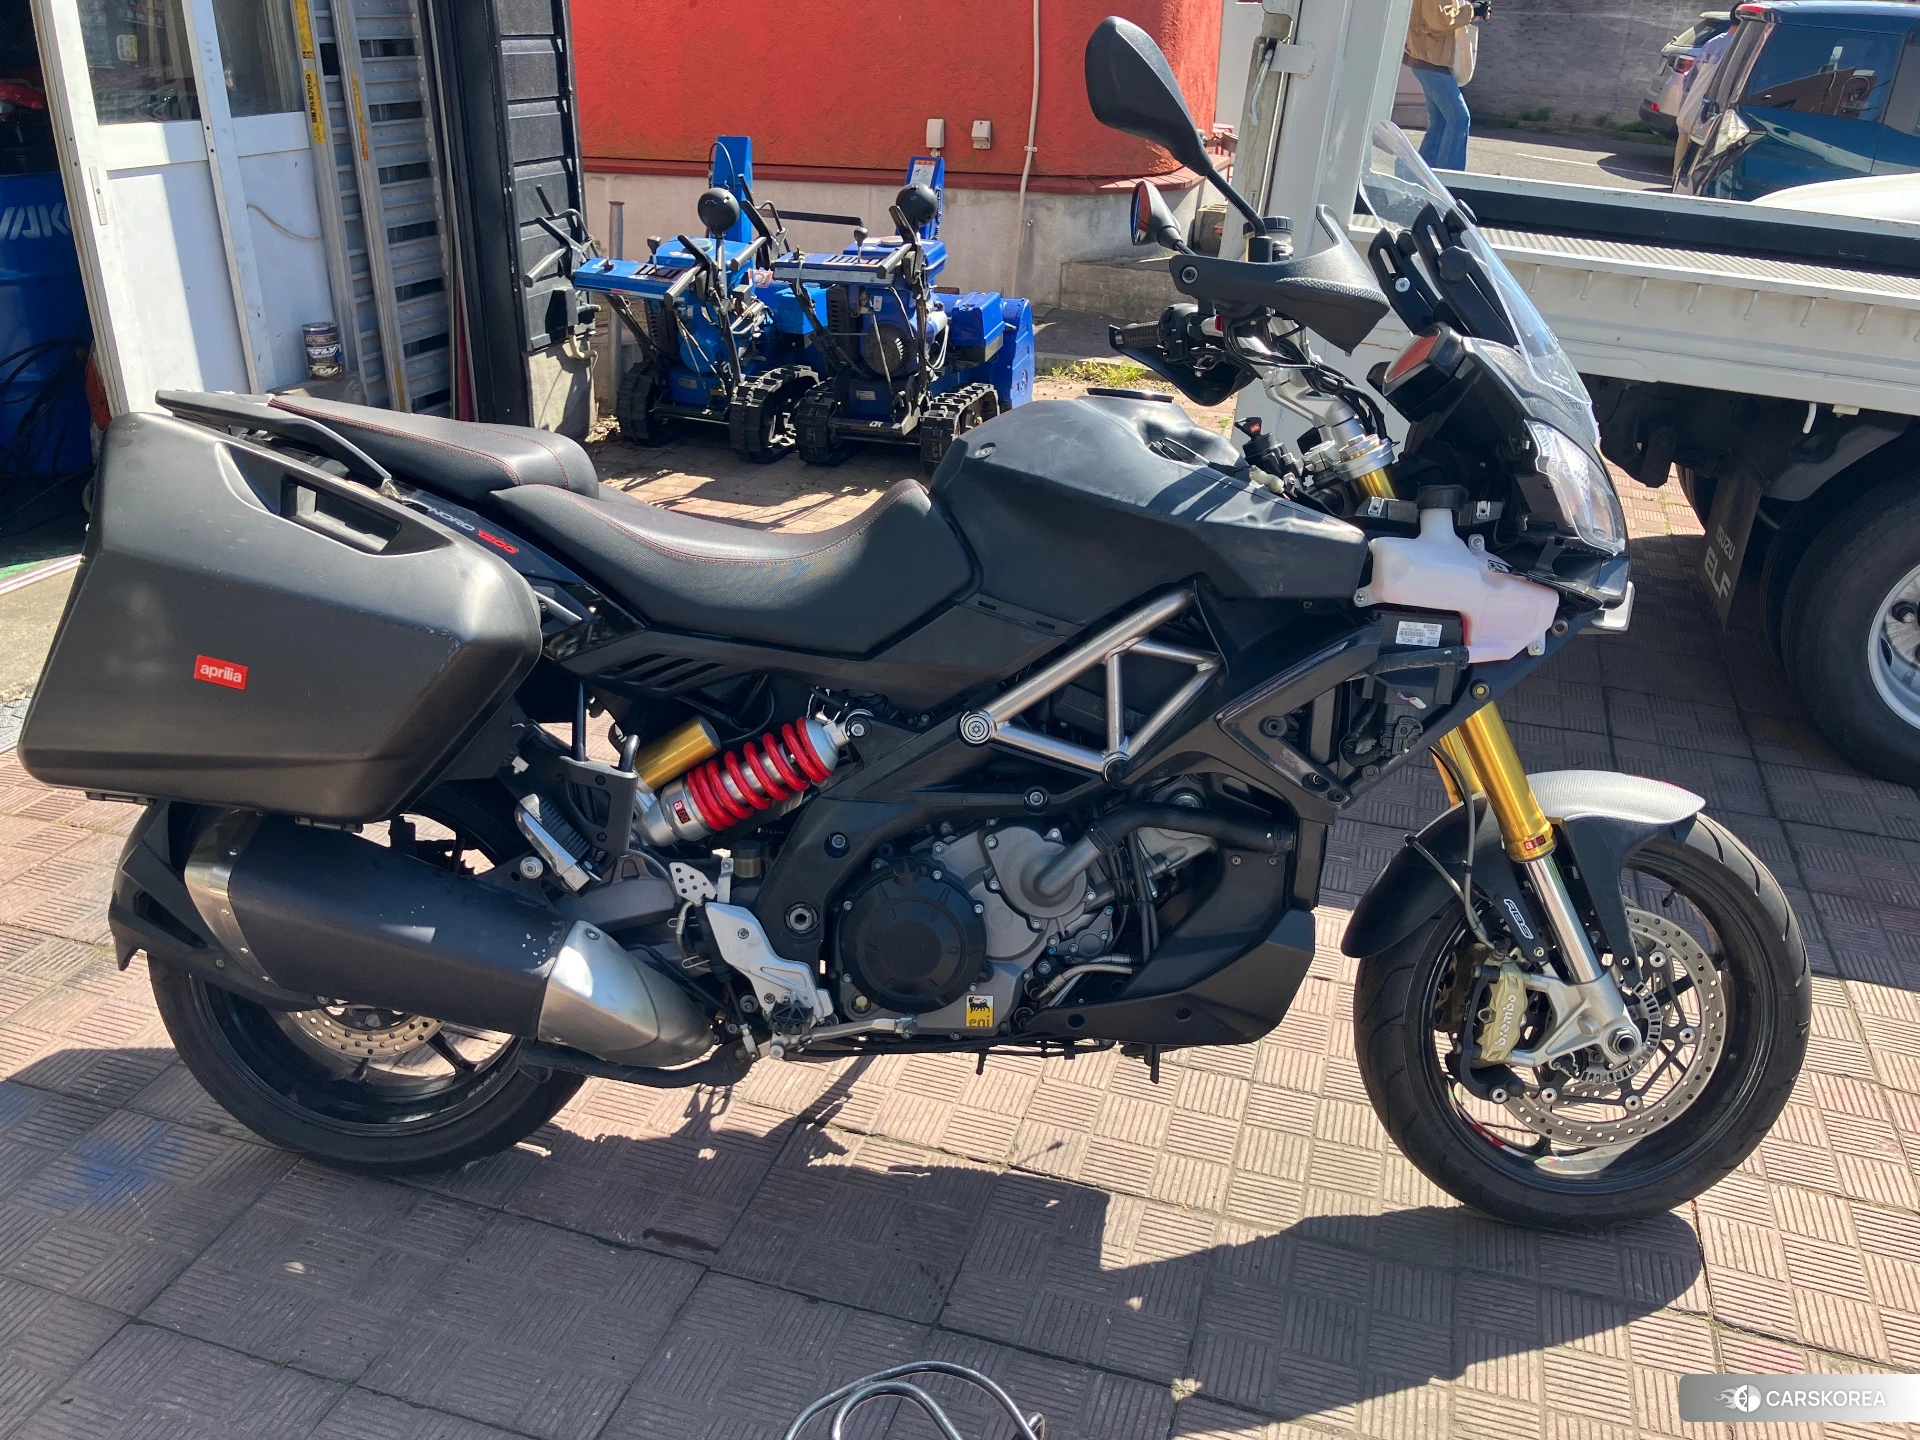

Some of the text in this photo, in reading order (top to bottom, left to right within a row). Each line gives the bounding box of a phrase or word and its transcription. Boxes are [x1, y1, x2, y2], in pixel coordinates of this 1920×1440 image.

[1716, 524, 1736, 561] ISUZU
[1704, 546, 1732, 598] ELF
[200, 664, 243, 683] aprilia
[1503, 898, 1534, 940] ABS
[968, 1015, 991, 1028] eni
[1495, 994, 1516, 1046] brembo
